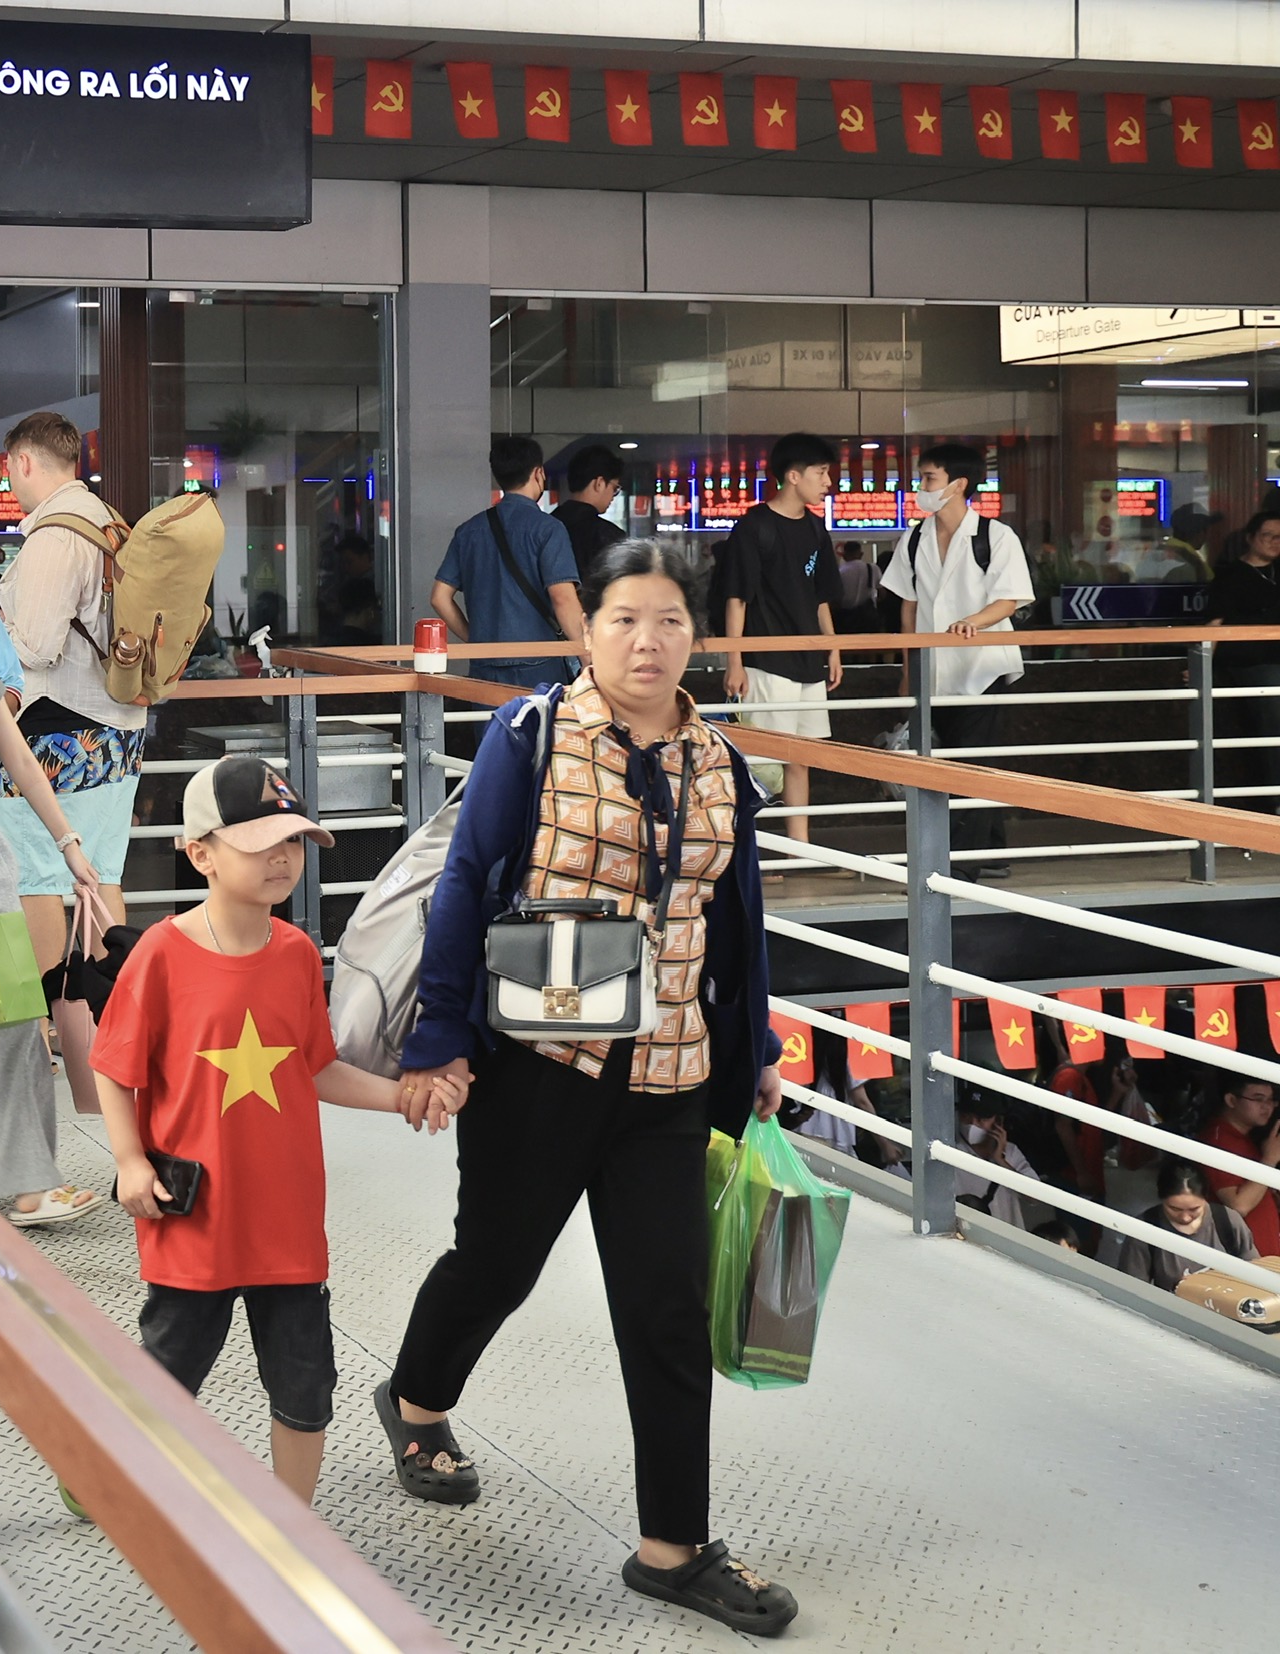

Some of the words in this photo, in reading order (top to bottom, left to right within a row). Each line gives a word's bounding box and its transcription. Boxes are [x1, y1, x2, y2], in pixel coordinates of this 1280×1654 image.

[80, 71, 121, 97] RA
[130, 63, 177, 99] LỐI
[187, 67, 250, 101] NÀY
[1036, 322, 1090, 343] Departure
[1094, 320, 1122, 334] Gate
